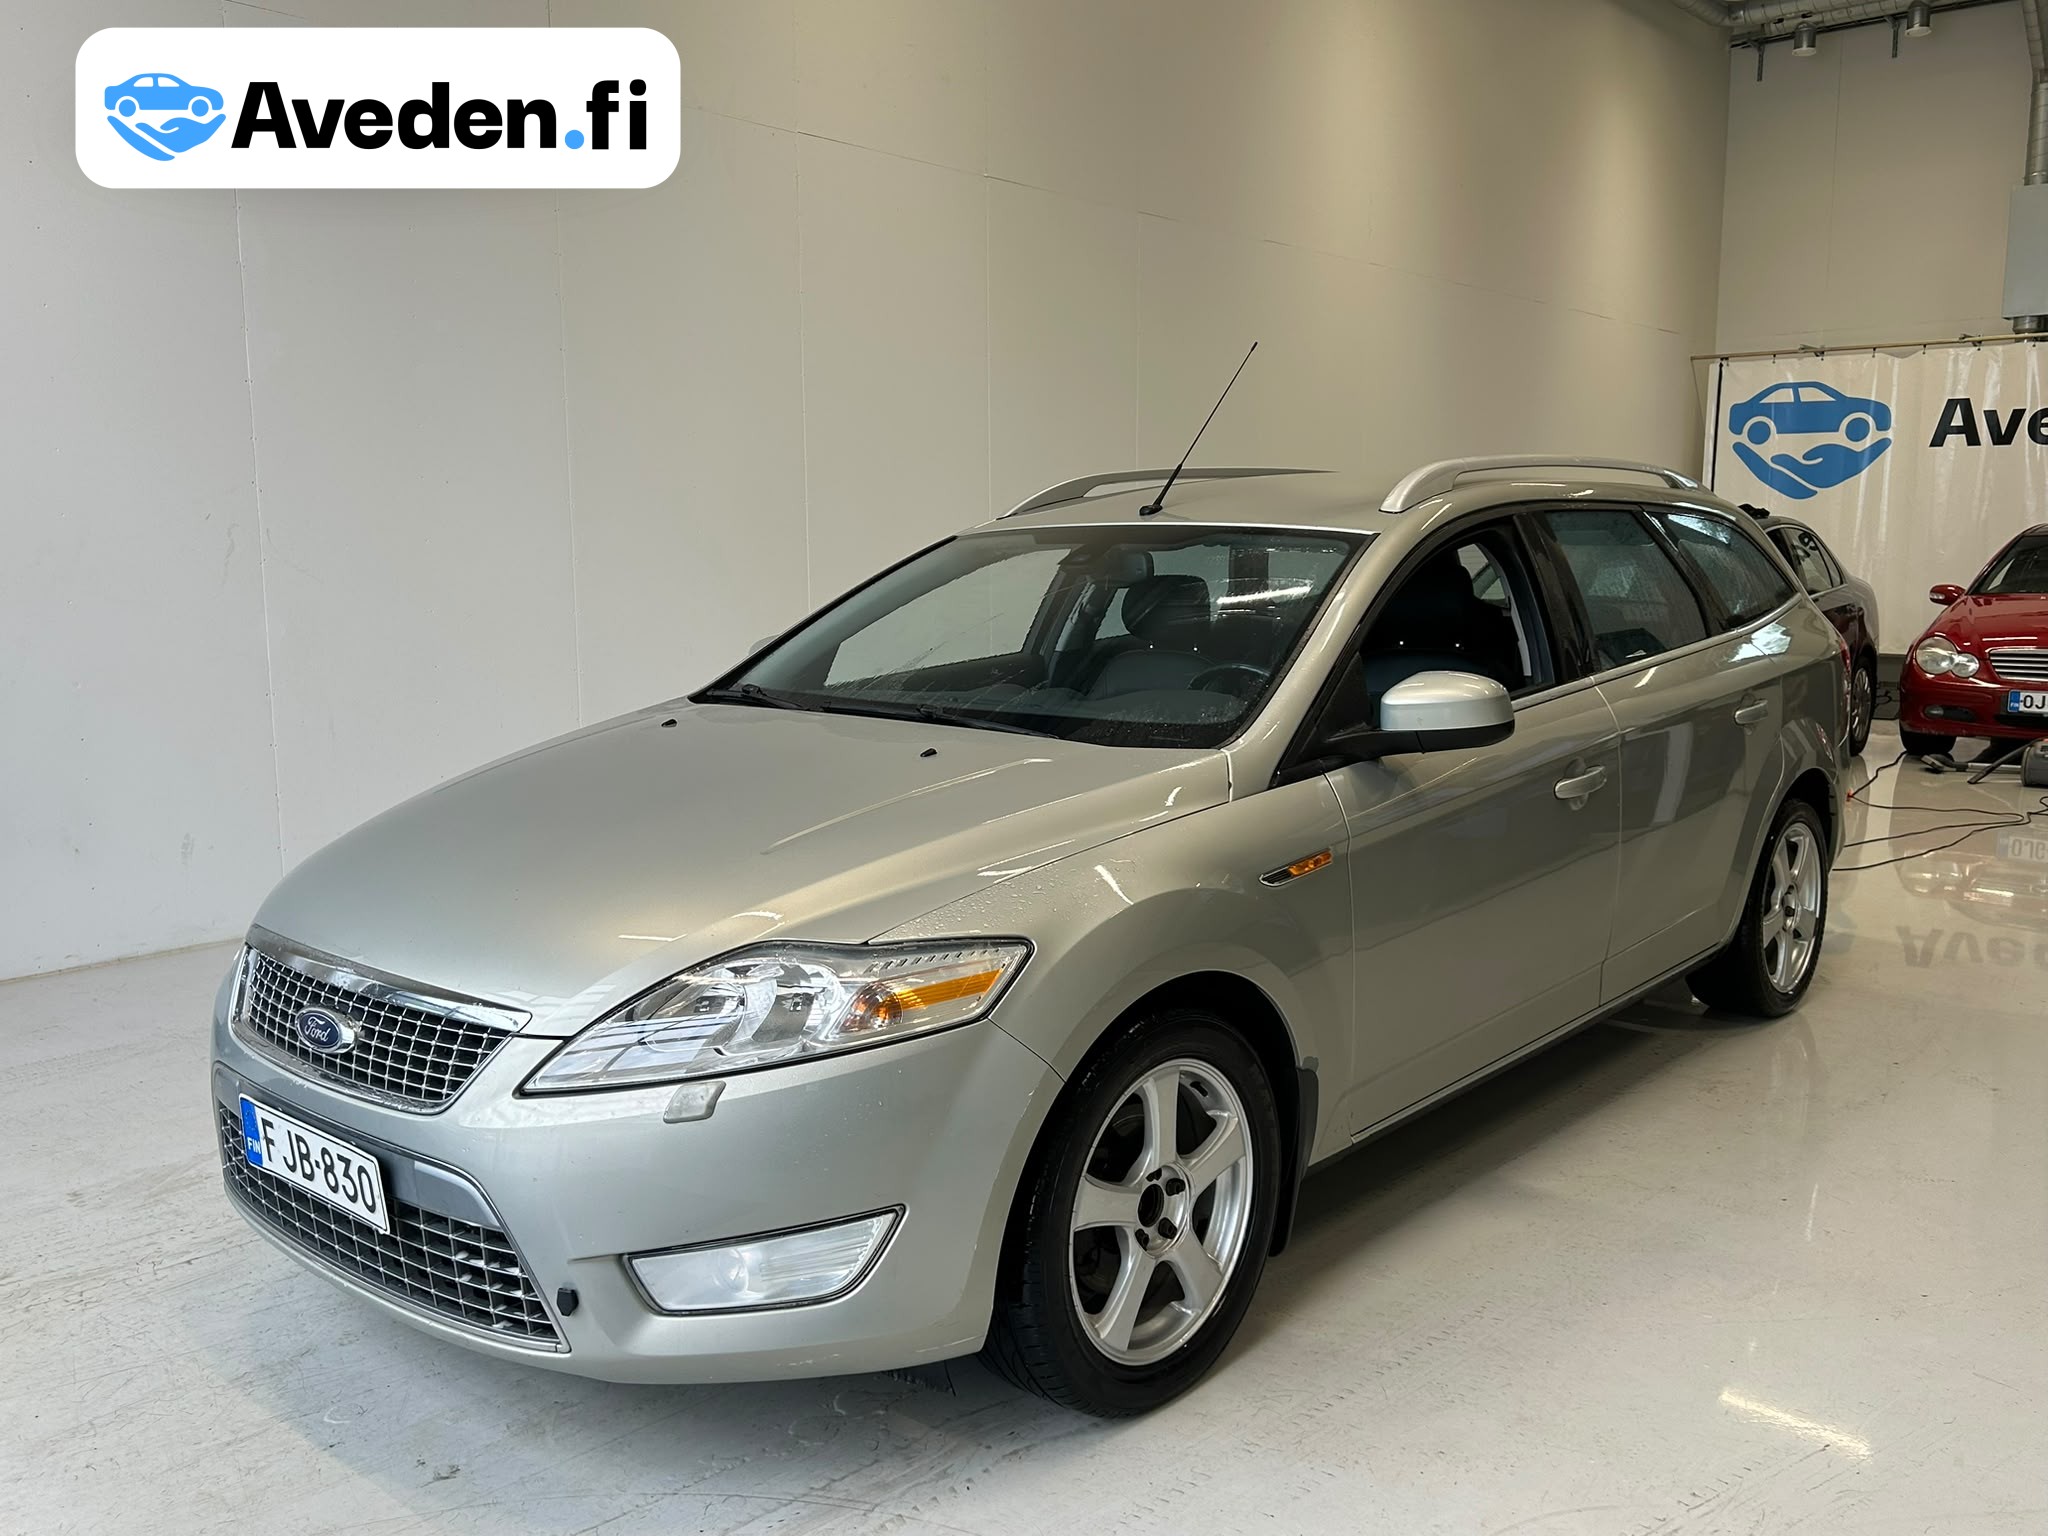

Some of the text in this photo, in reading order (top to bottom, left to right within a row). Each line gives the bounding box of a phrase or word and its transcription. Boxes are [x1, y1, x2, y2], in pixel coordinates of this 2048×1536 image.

[305, 1016, 331, 1042] Ford
[247, 1137, 261, 1155] FIN
[261, 1117, 377, 1214] FJB-830
